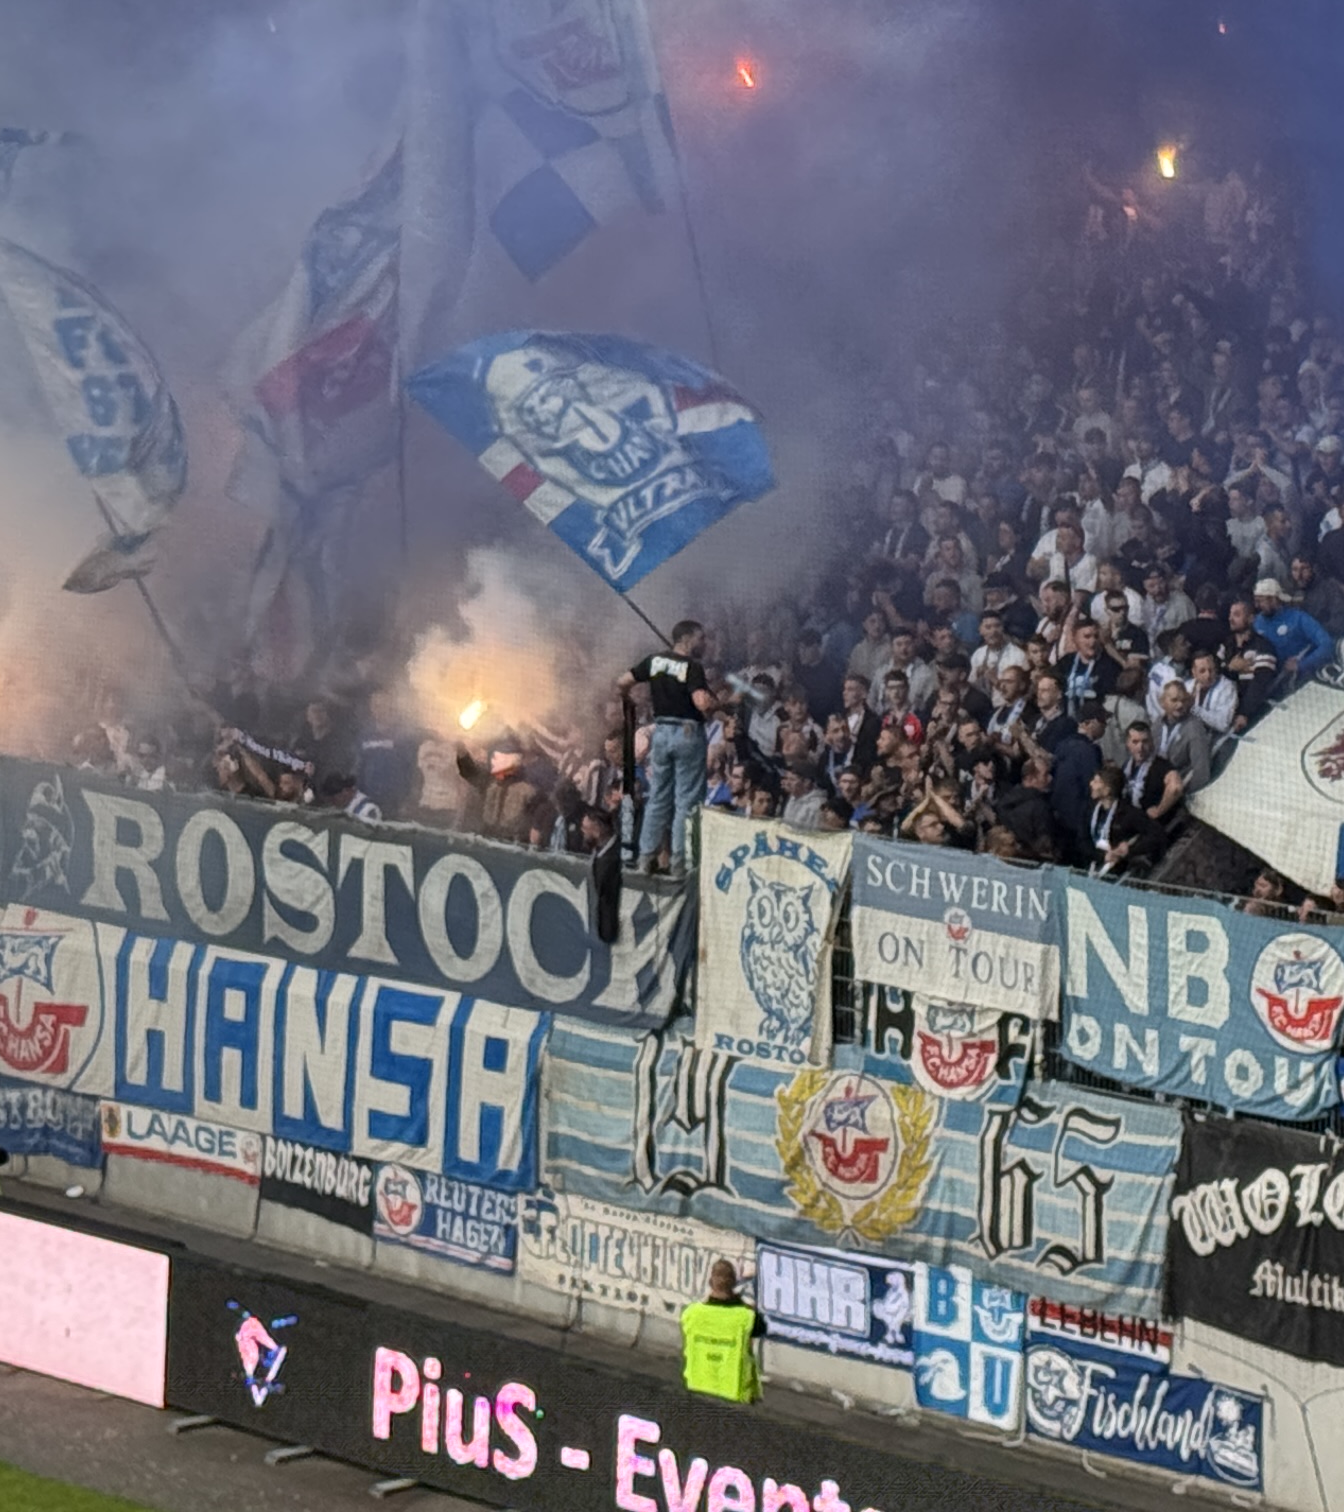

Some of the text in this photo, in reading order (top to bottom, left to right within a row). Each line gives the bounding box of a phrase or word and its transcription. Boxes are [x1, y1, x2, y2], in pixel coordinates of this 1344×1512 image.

[80, 788, 693, 1031] ROSTOCK
[865, 853, 1053, 922] SCHWERIN
[877, 931, 1040, 995] ON TOUR
[1065, 885, 1231, 1030] NB
[122, 928, 546, 1175] HANSA
[1067, 1011, 1159, 1077] ON
[126, 1110, 238, 1160] LAAGE
[436, 1209, 506, 1255] HAGEN
[373, 1345, 546, 1481] PiuS
[615, 1414, 882, 1512] Even
[1062, 1358, 1216, 1464] Fischland
